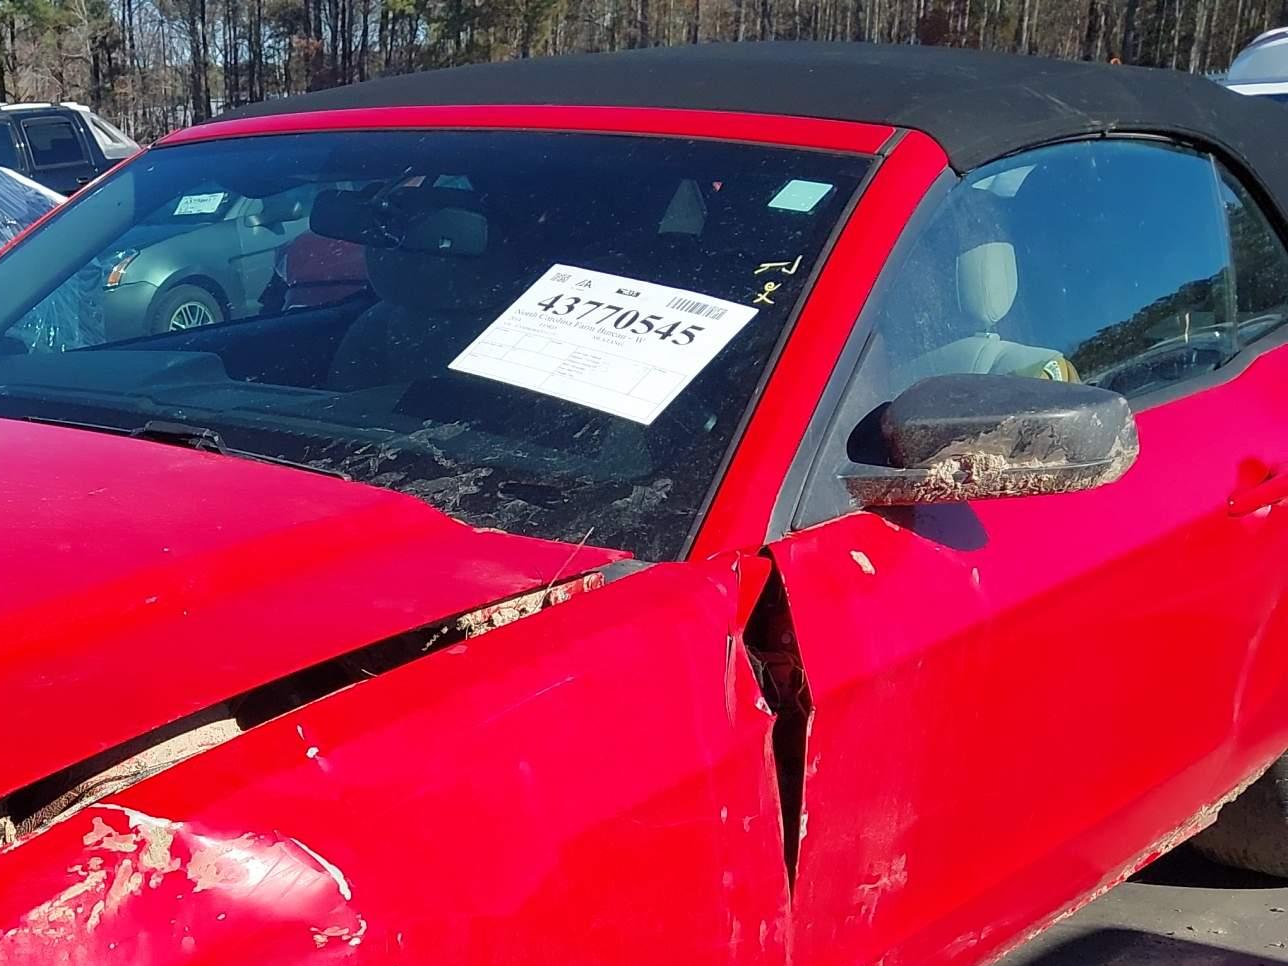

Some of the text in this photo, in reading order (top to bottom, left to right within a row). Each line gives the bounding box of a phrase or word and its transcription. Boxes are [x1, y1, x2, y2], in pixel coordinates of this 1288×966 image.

[513, 307, 539, 319] North
[536, 312, 574, 328] Carolina
[572, 321, 597, 332] Farm
[595, 327, 629, 341] Bureau
[537, 293, 705, 346] 43770545
